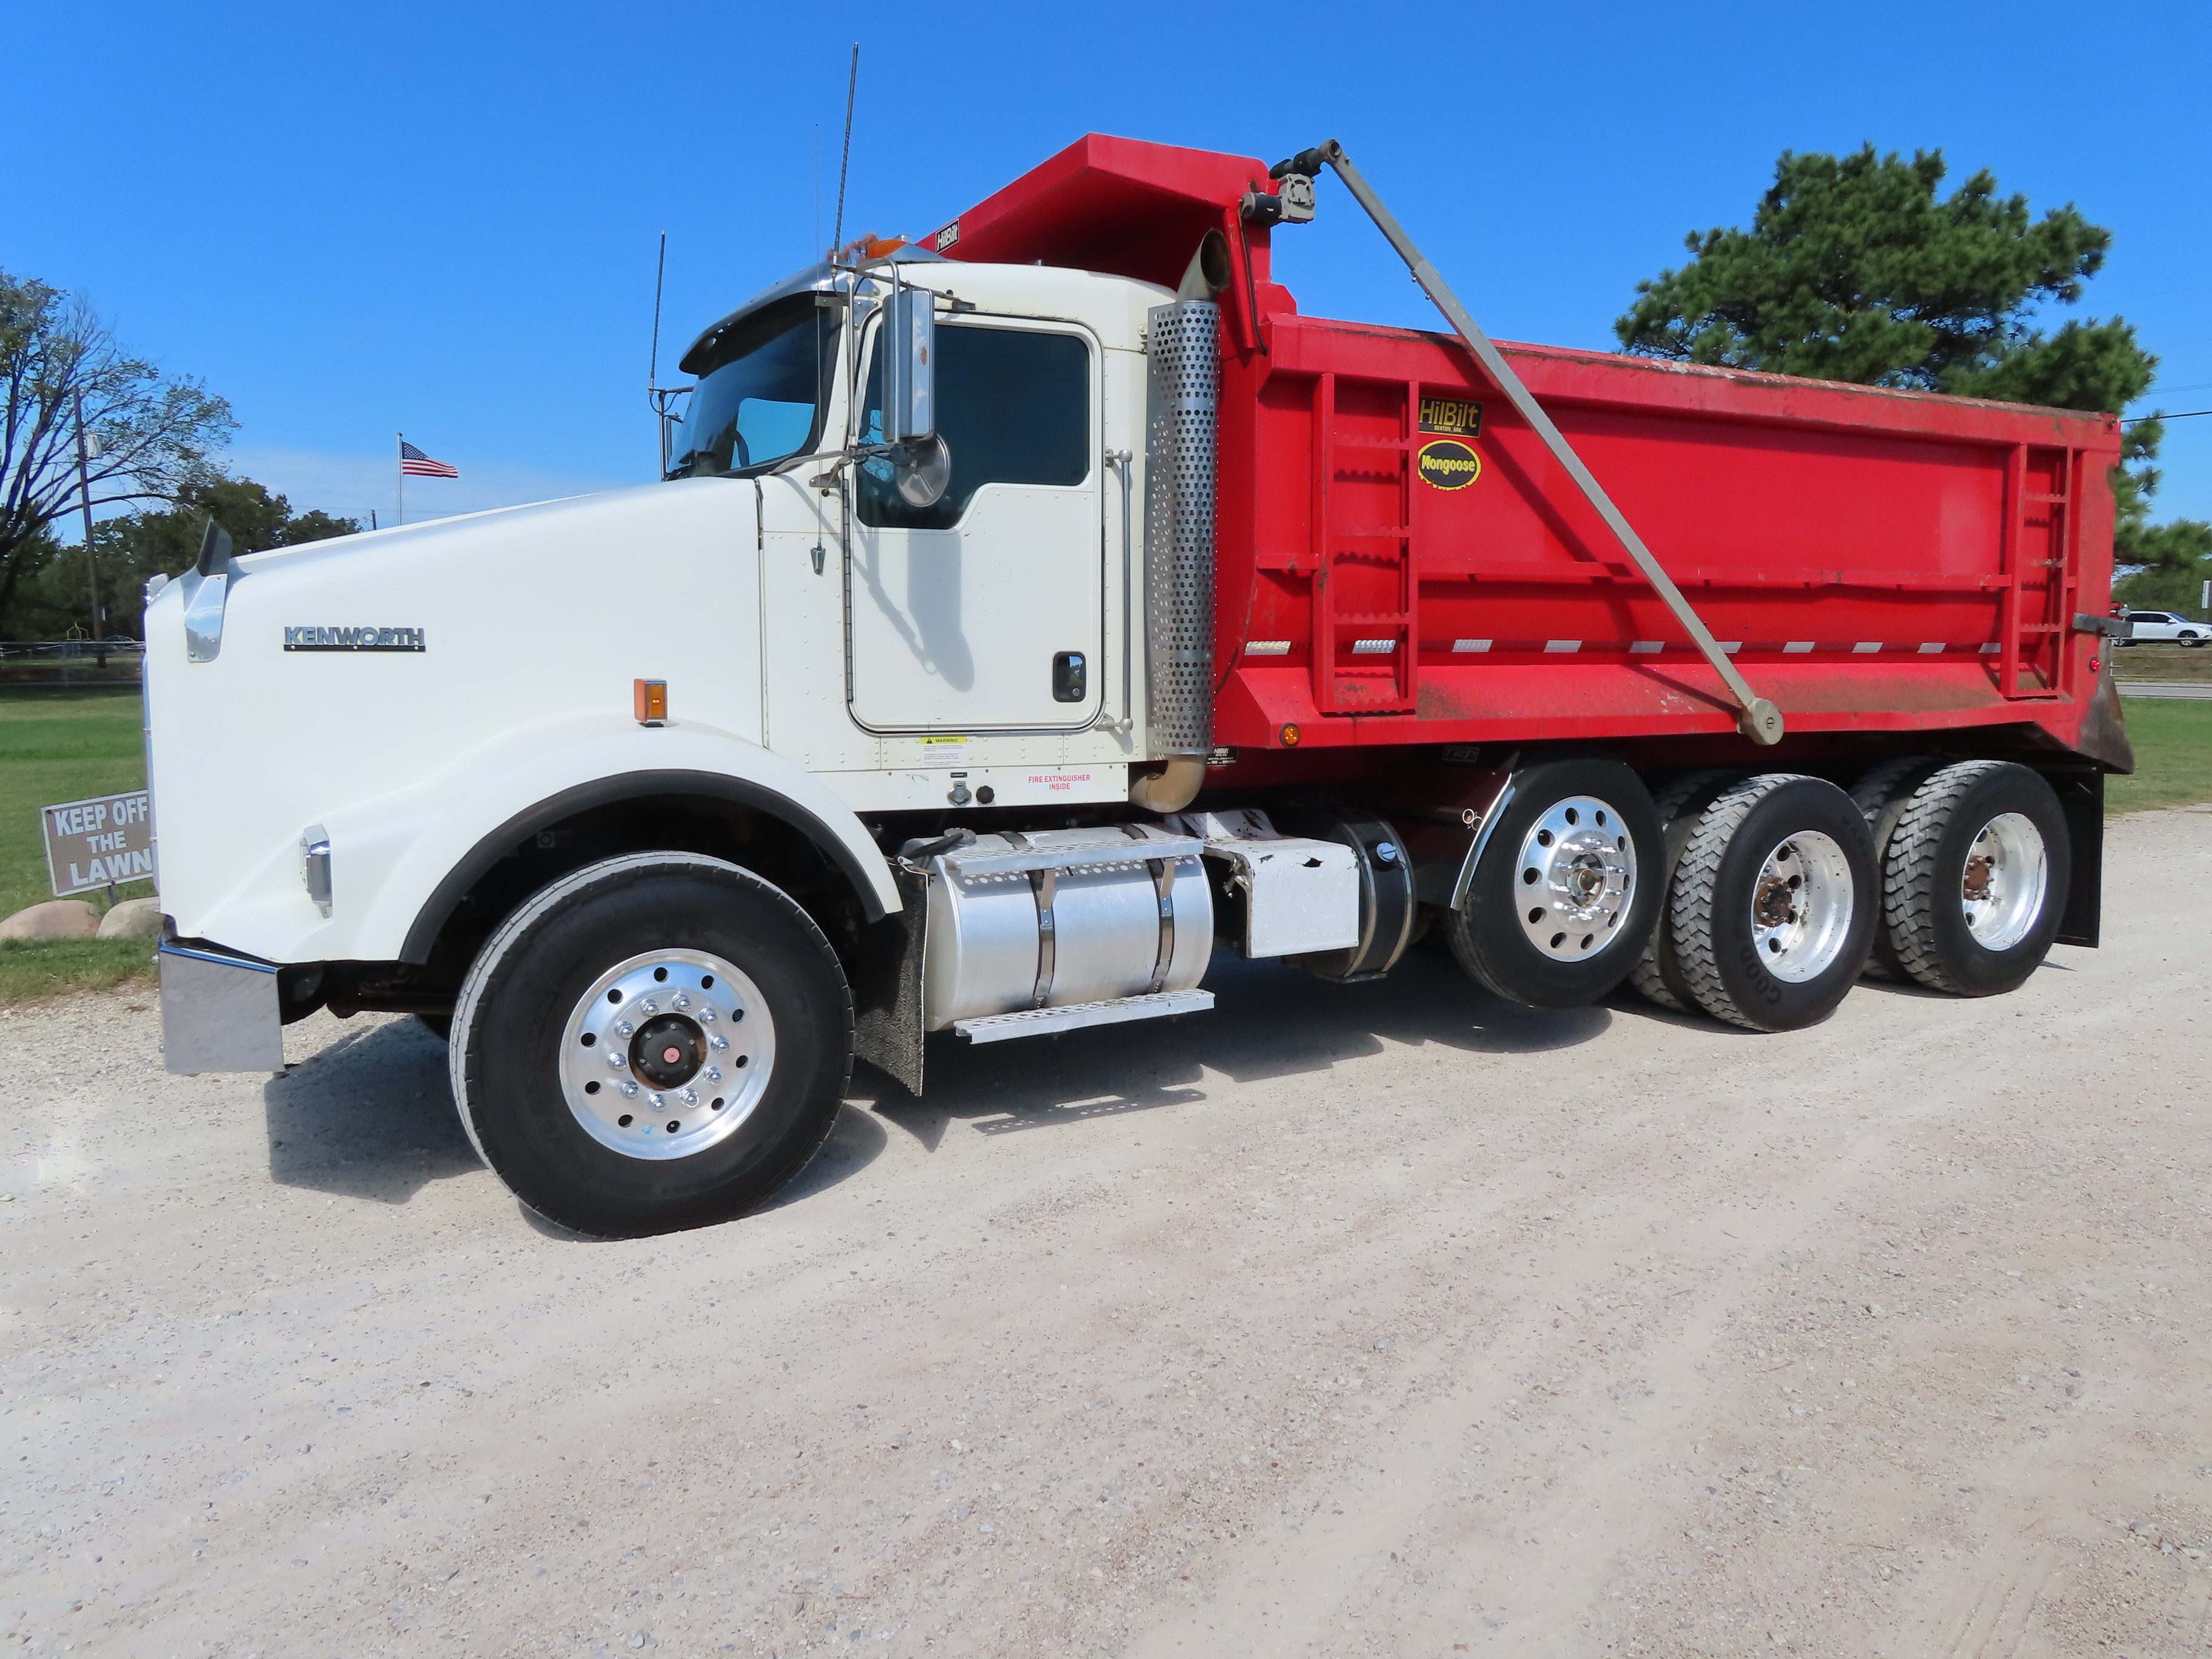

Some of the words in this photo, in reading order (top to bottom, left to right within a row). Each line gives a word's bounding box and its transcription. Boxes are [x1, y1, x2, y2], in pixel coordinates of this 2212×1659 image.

[937, 224, 957, 251] HilBilt
[1418, 400, 1478, 428] HilBilt
[1421, 454, 1475, 475] Mongoose
[284, 626, 424, 646] KENWORTH
[55, 804, 107, 837] KEEP
[112, 797, 147, 826] OFF
[86, 831, 127, 854] THE
[69, 848, 152, 886] LAWN
